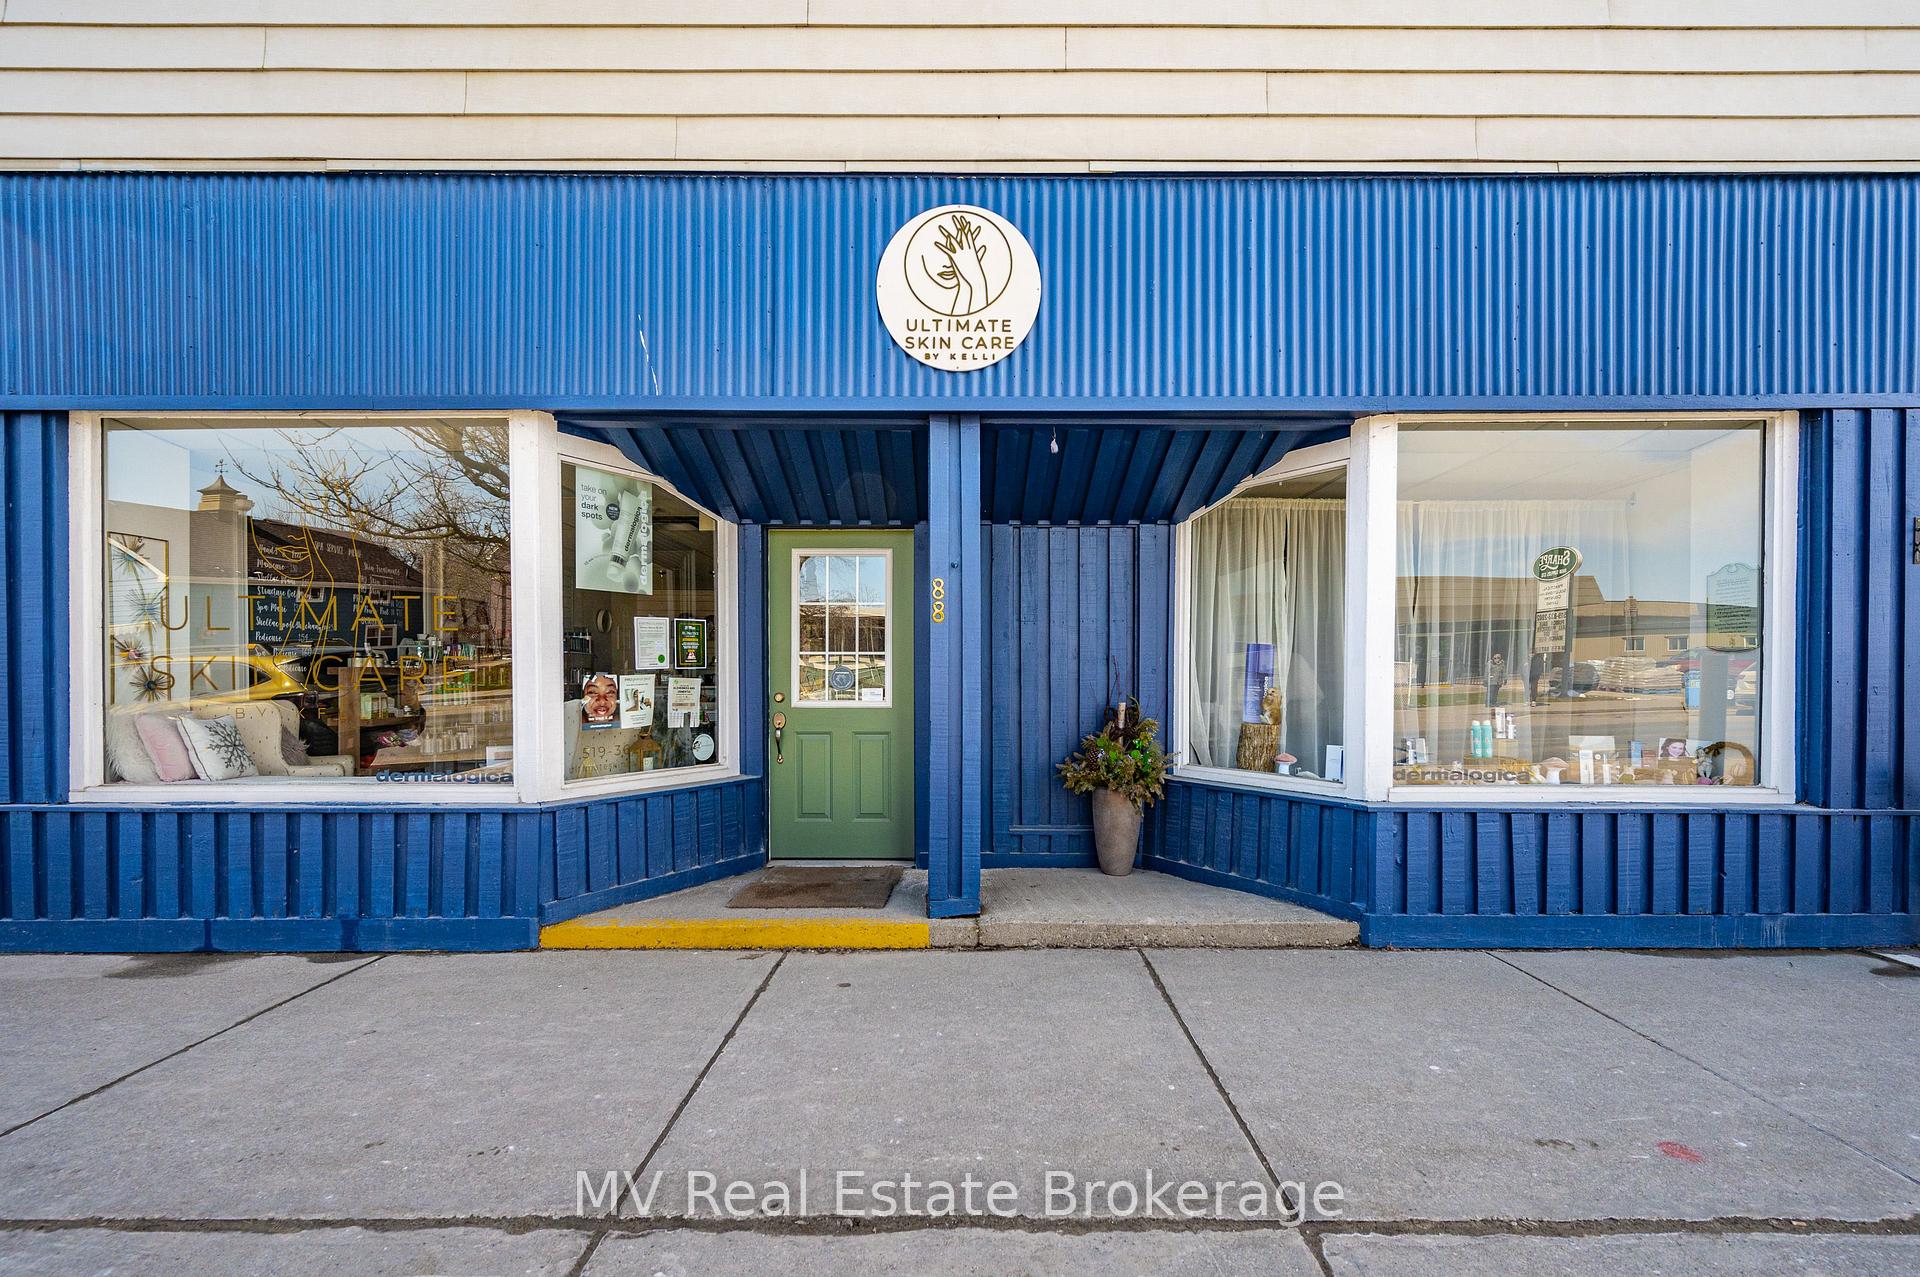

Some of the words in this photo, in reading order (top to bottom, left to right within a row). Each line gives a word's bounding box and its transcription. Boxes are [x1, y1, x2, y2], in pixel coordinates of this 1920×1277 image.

[906, 319, 1011, 332] ULTIMATE
[905, 336, 951, 349] SKIN
[961, 336, 1014, 349] CARE
[581, 484, 596, 493] take
[581, 494, 596, 502] your
[581, 502, 599, 511] dark
[581, 510, 603, 521] spots
[160, 595, 460, 631] ULTIMATE
[312, 655, 468, 692] CARE
[375, 769, 514, 784] dermalogica
[1393, 769, 1530, 783] dermalogica
